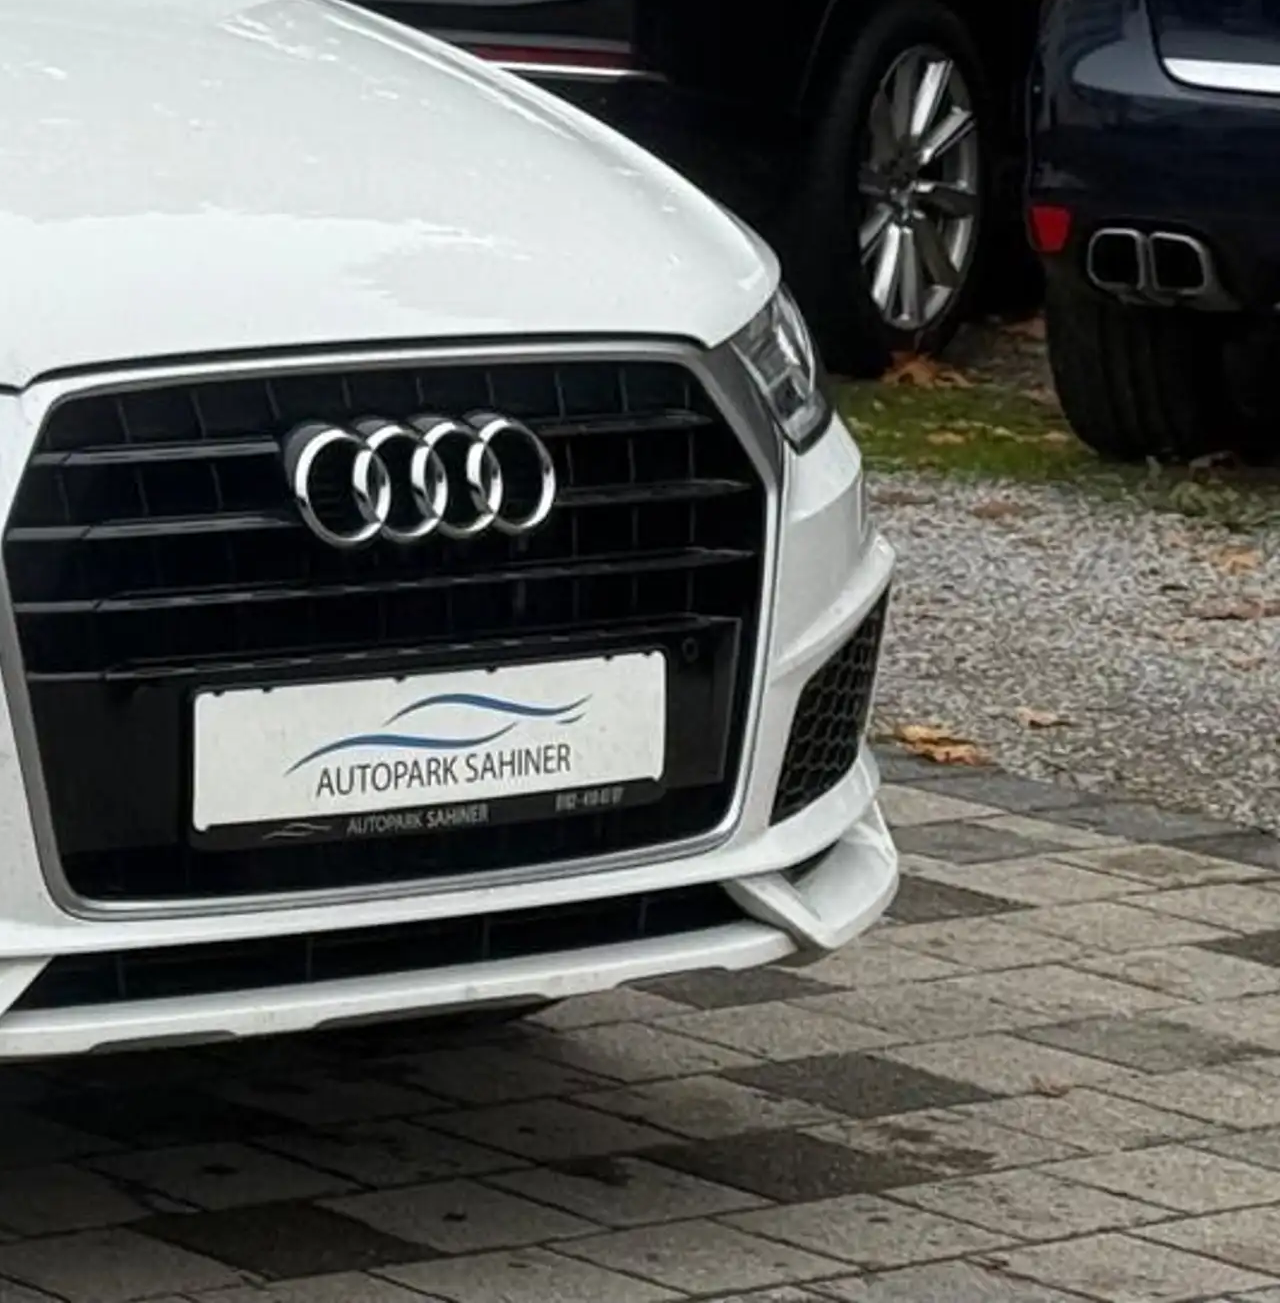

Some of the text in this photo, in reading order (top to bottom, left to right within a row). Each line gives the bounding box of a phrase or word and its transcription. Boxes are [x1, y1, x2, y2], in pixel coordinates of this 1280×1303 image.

[315, 743, 572, 798] AUTOPARK SAHINER
[346, 803, 489, 836] AUTOPARK SAHINER
